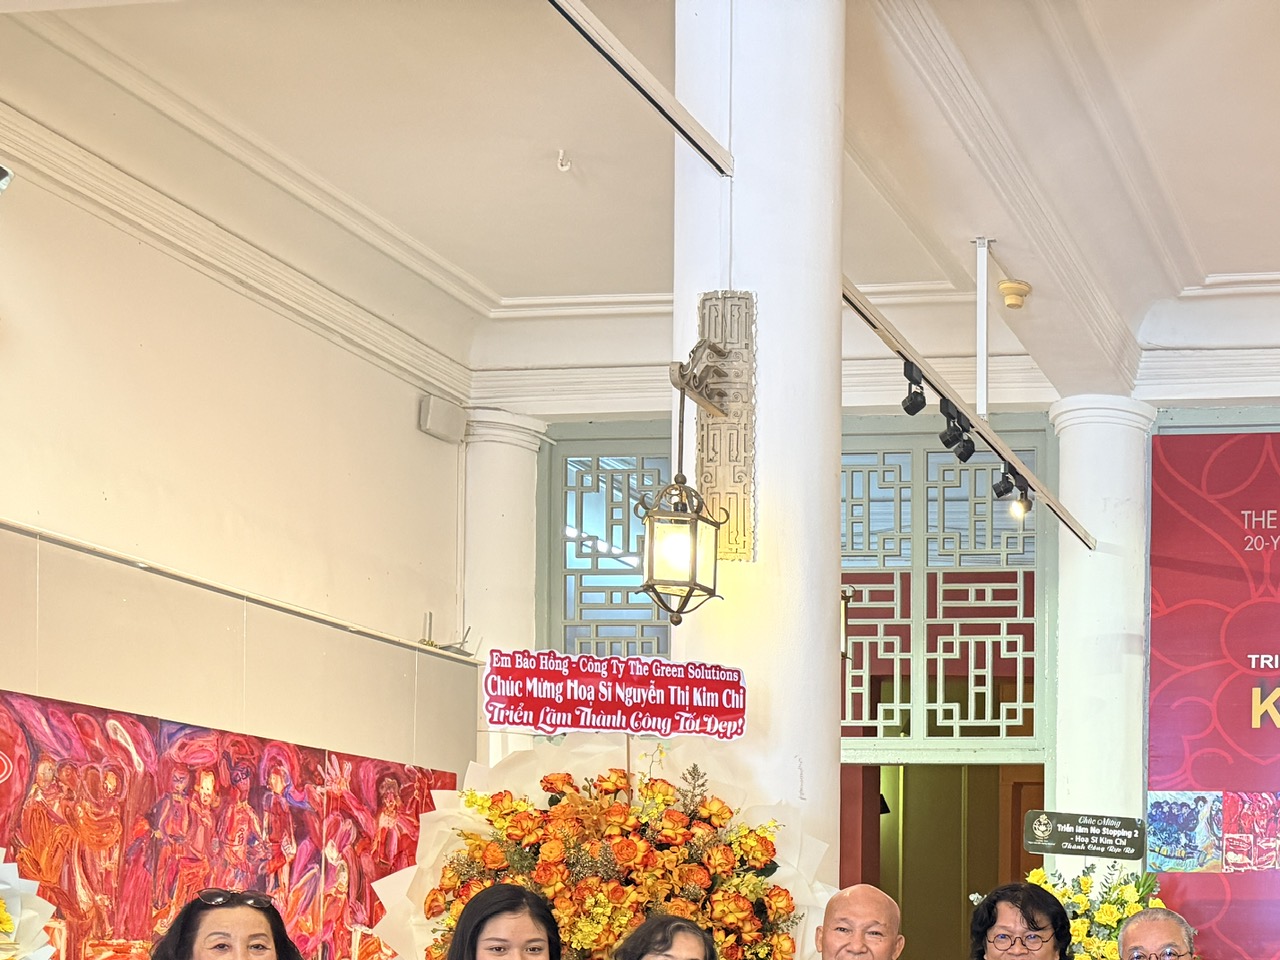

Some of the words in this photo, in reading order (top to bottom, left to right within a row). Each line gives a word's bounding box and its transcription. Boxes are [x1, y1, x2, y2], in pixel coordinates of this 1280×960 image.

[1241, 509, 1277, 529] THE
[492, 652, 512, 668] Em
[515, 652, 536, 669] Bảo
[539, 653, 569, 676] Hồng
[580, 657, 608, 678] Công
[611, 659, 625, 678] Ty
[628, 660, 649, 676] The
[652, 661, 685, 678] Green
[688, 664, 739, 682] Solutions
[487, 675, 523, 697] Chúc
[526, 677, 564, 703] Mừng
[566, 679, 595, 706] Hoạ
[598, 681, 612, 702] Sĩ
[615, 680, 665, 707] Nguyễn
[668, 685, 689, 711] Thị
[693, 686, 719, 707] Kim
[722, 688, 744, 709] Chi
[488, 702, 534, 724] Triển
[537, 706, 572, 731] Lãm
[575, 706, 627, 728] Thành
[630, 711, 672, 735] Công
[674, 711, 700, 732] Tốt
[1090, 826, 1101, 834] No
[1102, 827, 1133, 838] Stopping
[1115, 838, 1127, 846] Chi
